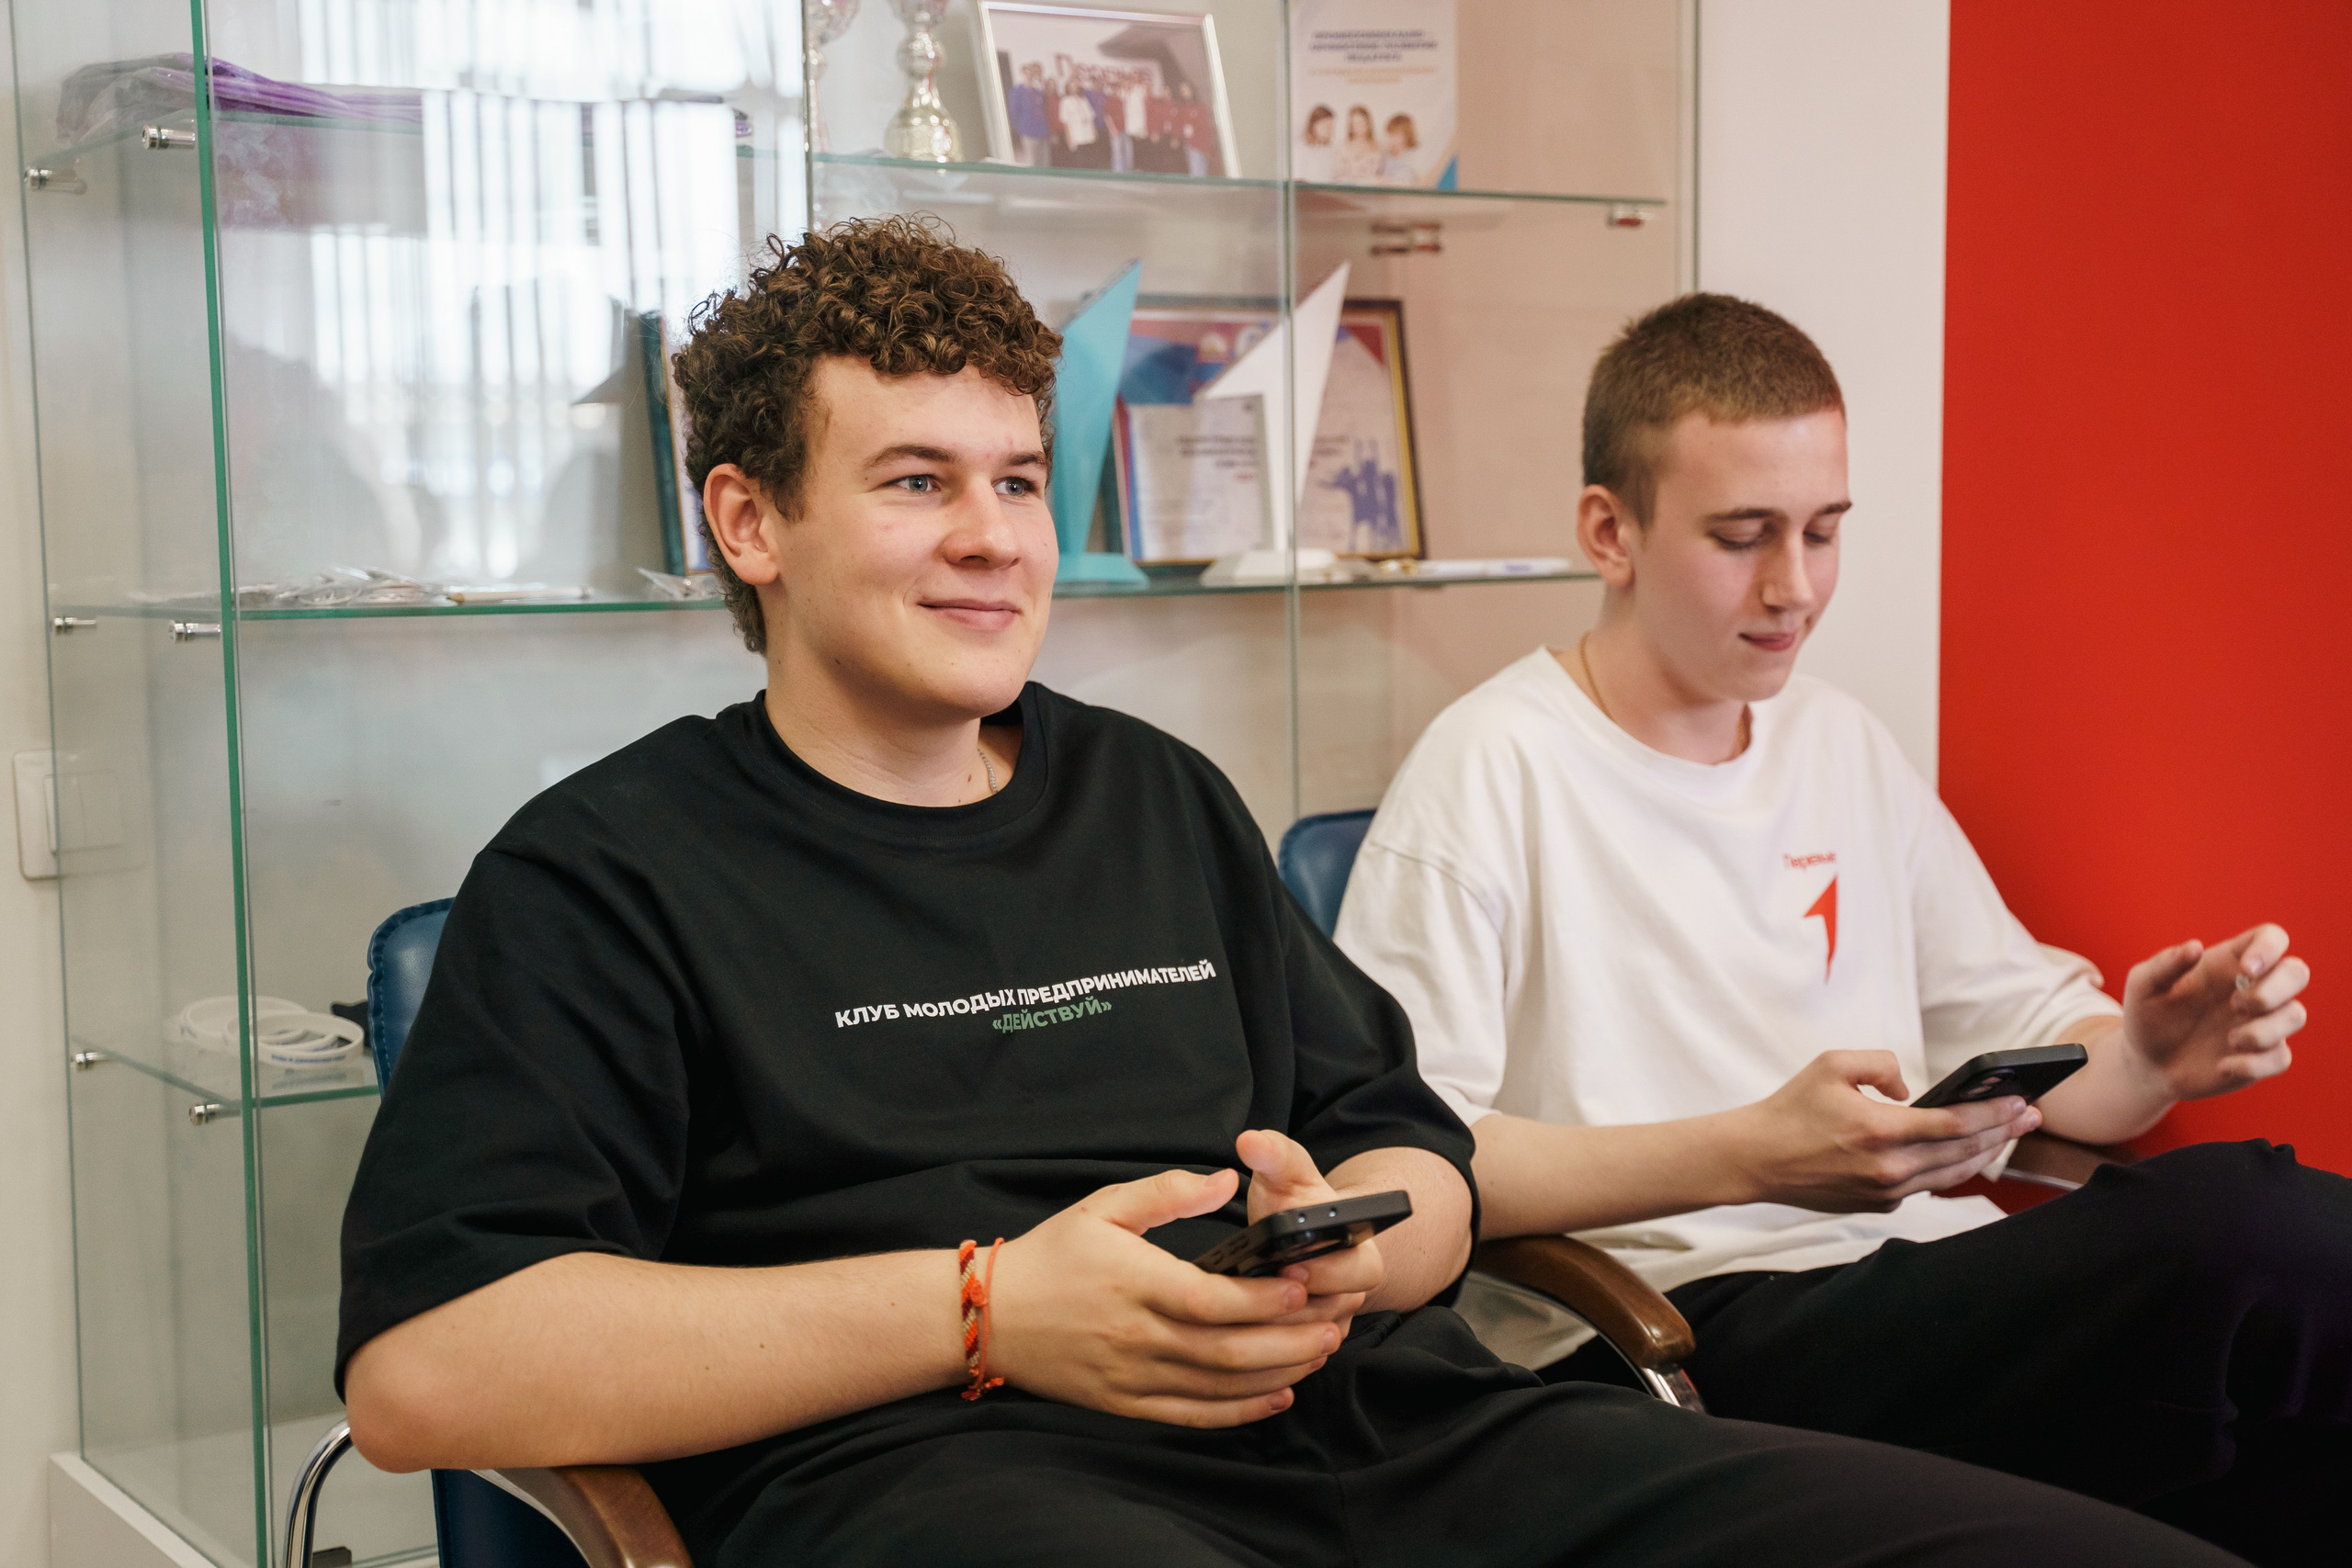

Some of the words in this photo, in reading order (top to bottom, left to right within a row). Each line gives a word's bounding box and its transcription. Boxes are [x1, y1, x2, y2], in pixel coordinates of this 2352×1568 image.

[835, 1004, 899, 1028] КЛУБ
[902, 988, 1016, 1018] МОЛОДЫХ
[1017, 959, 1216, 1005] ПРЕДПРИНИМАТЕЛЕЙ
[992, 996, 1112, 1033] «ДЕЙСТВУЙ»
